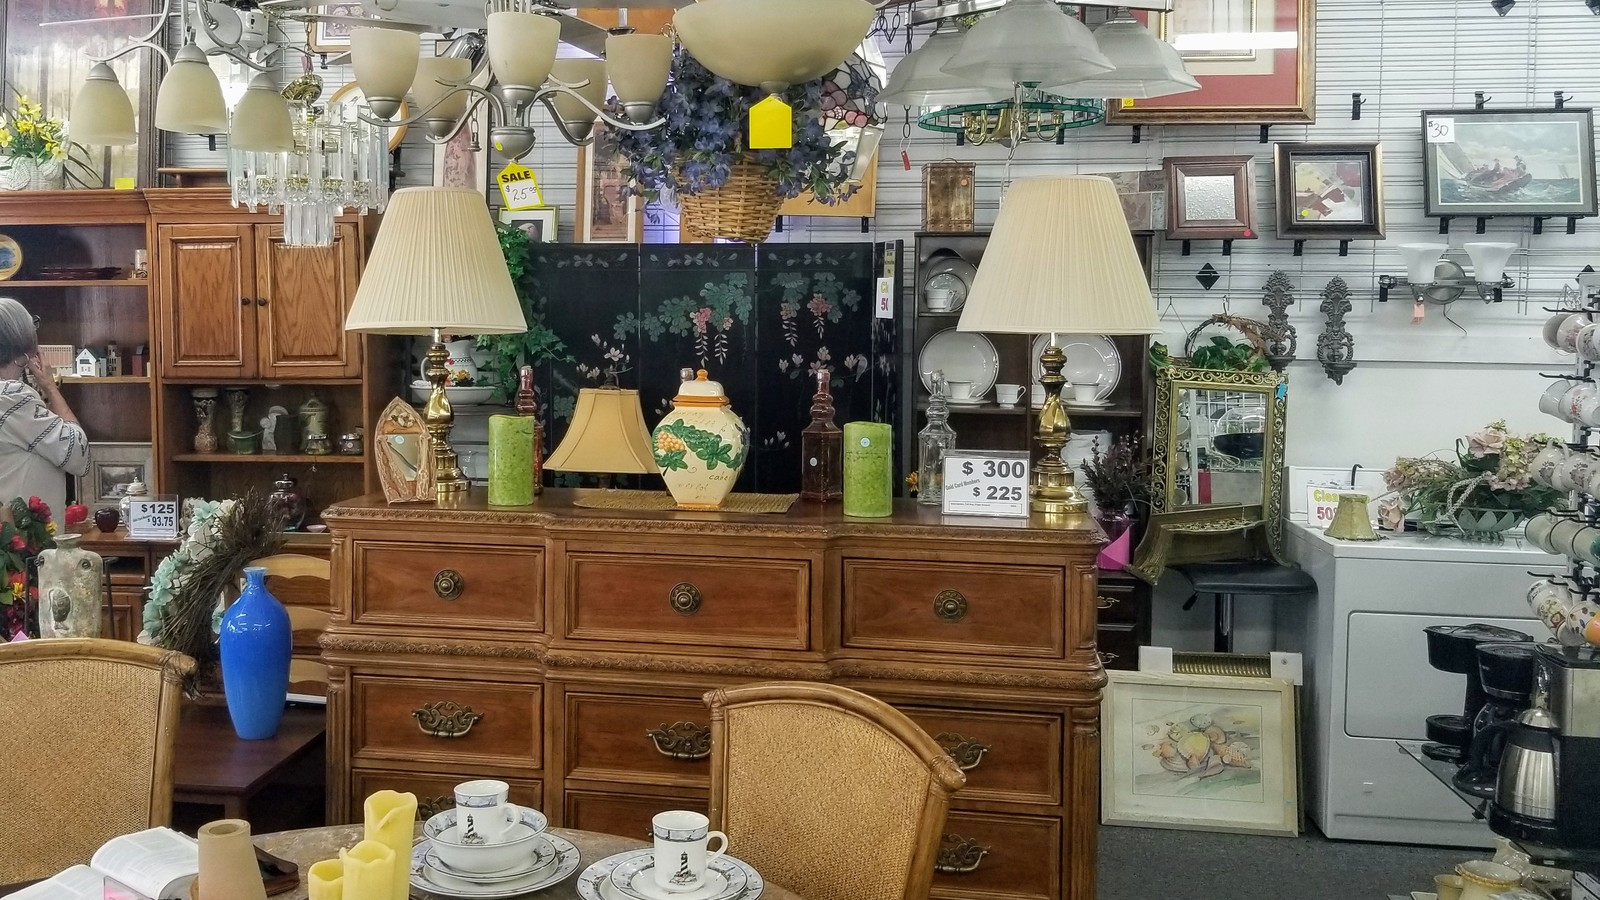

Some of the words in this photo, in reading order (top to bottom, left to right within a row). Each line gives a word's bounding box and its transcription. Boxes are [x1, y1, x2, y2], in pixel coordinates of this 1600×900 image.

[501, 170, 531, 183] SALE
[983, 460, 1025, 479] 300
[986, 485, 1022, 501] 225
